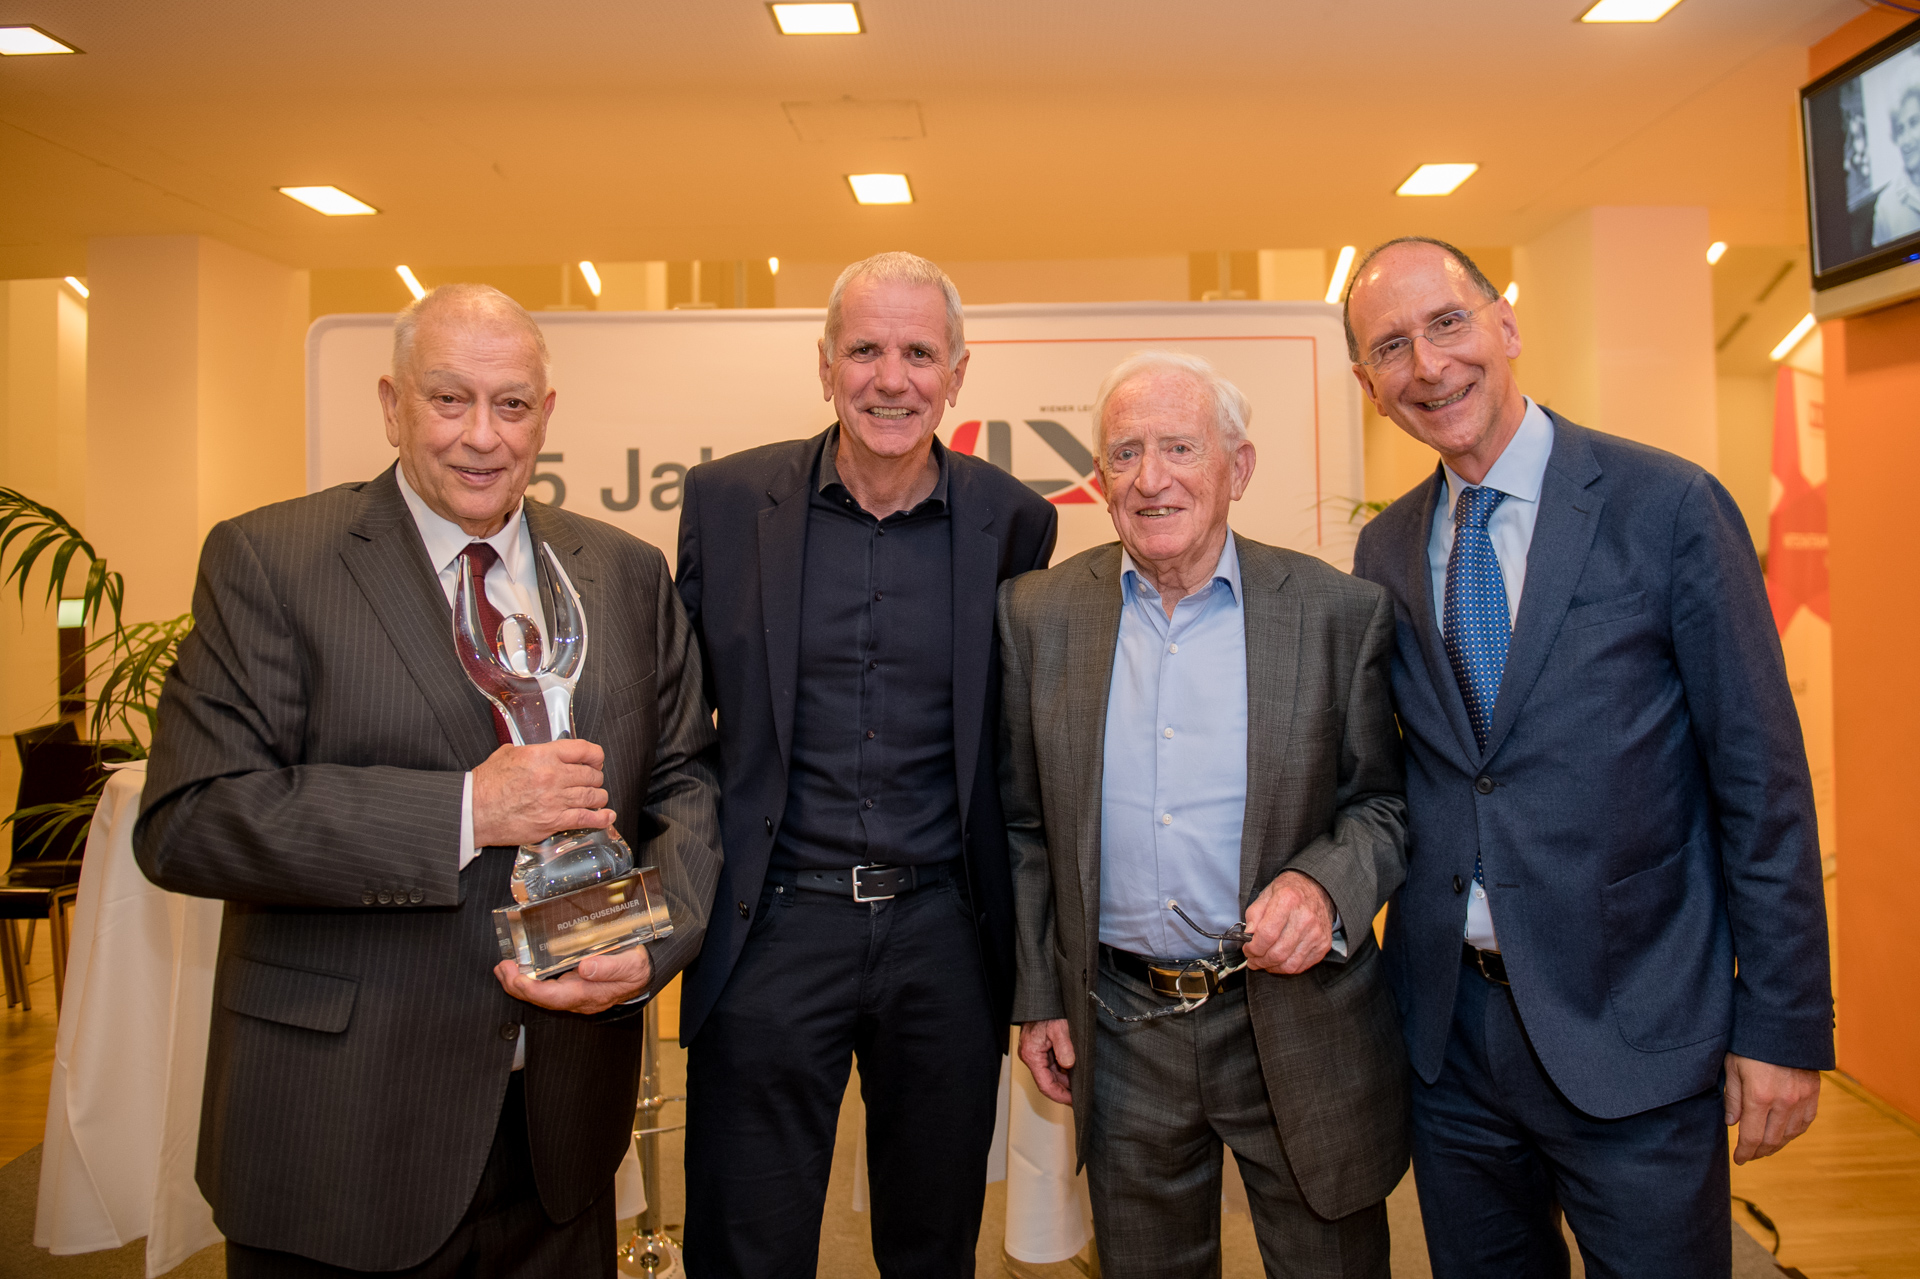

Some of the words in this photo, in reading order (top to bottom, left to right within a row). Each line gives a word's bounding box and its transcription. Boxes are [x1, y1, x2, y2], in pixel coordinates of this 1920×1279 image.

[1039, 405, 1074, 413] WIENER
[600, 447, 713, 512] Ja
[557, 915, 589, 931] ROLAND
[590, 899, 640, 920] GUSENBAUER
